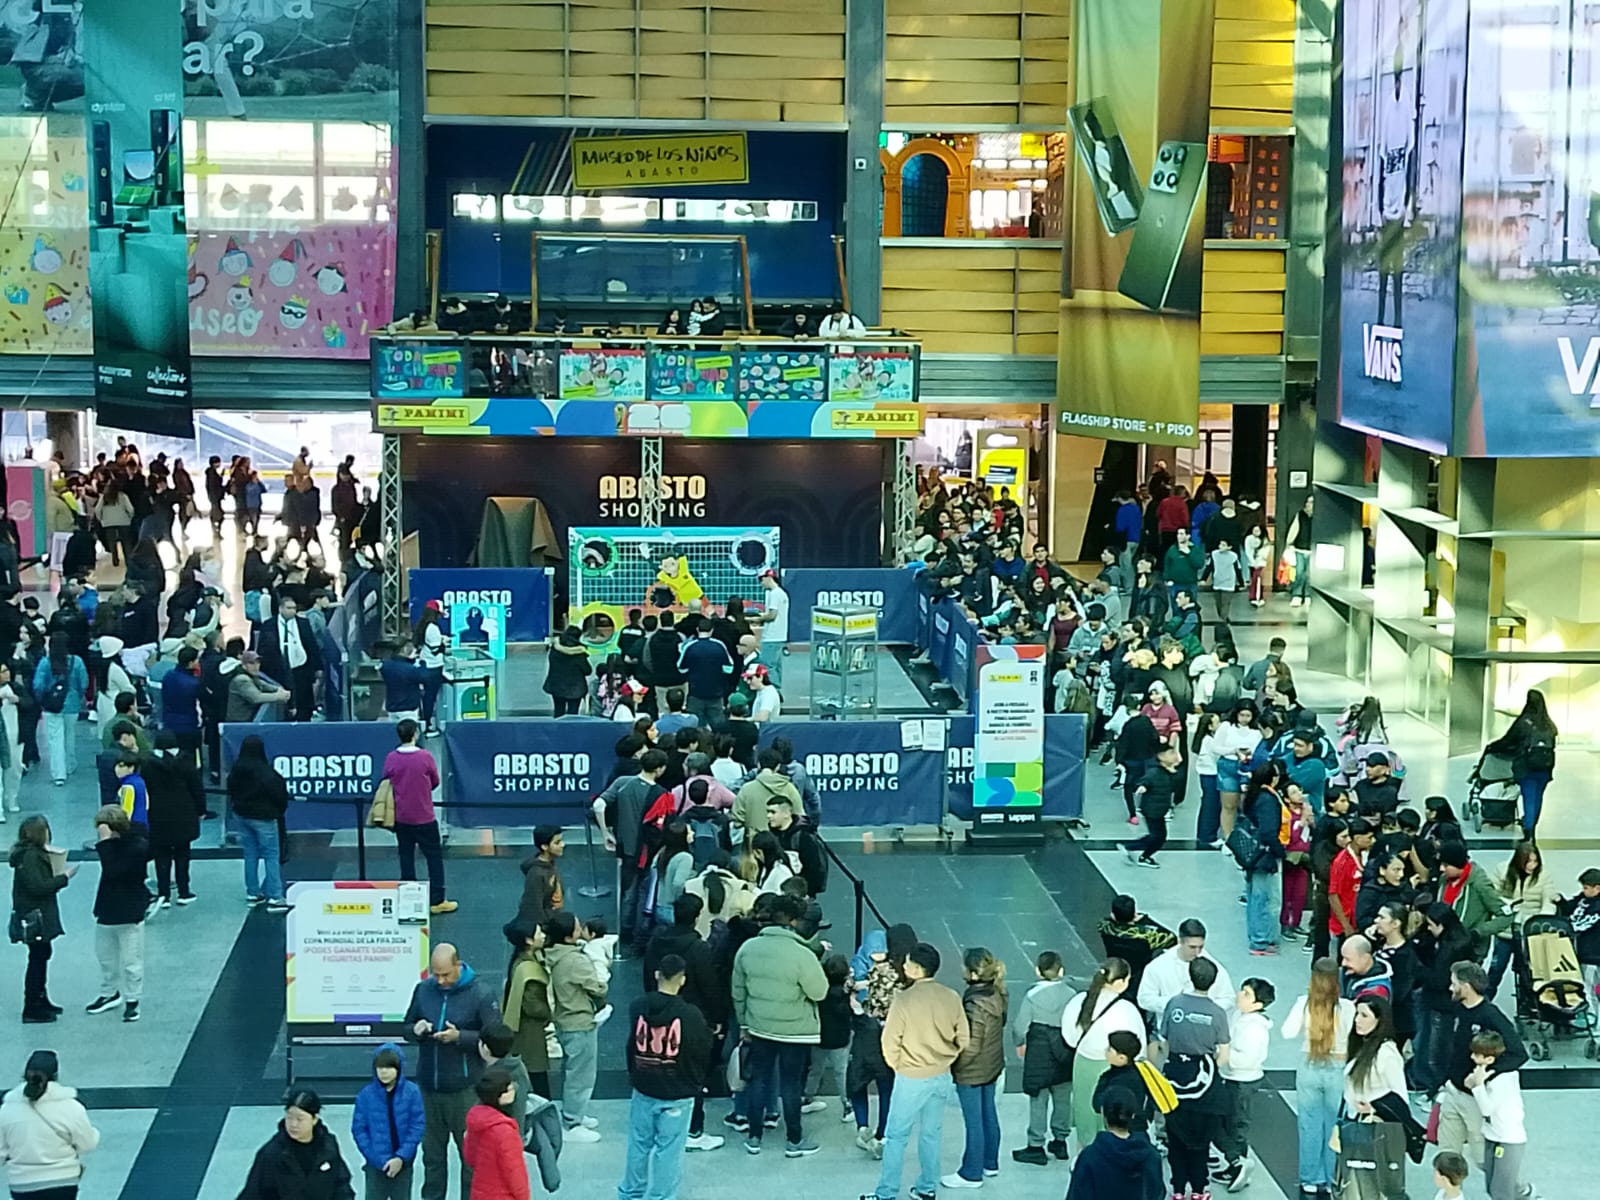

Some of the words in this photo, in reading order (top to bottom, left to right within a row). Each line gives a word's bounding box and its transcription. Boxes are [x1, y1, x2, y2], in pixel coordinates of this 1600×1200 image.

[582, 150, 634, 165] MUSEO
[636, 149, 651, 163] DE
[657, 147, 683, 161] LOS
[625, 166, 698, 178] ABASTO
[1363, 323, 1403, 382] VANS
[404, 408, 465, 419] PANINI
[856, 412, 915, 422] PANINI
[1061, 411, 1110, 427] FLAGSHIP
[1112, 418, 1147, 432] STORE
[1167, 423, 1194, 436] PISO
[274, 754, 373, 778] ABASTO
[494, 753, 591, 775] ABASTO
[806, 752, 899, 775] ABASTO
[286, 780, 373, 794] HOPPING
[494, 777, 590, 792] SHOPPING
[816, 776, 899, 791] HOPPING
